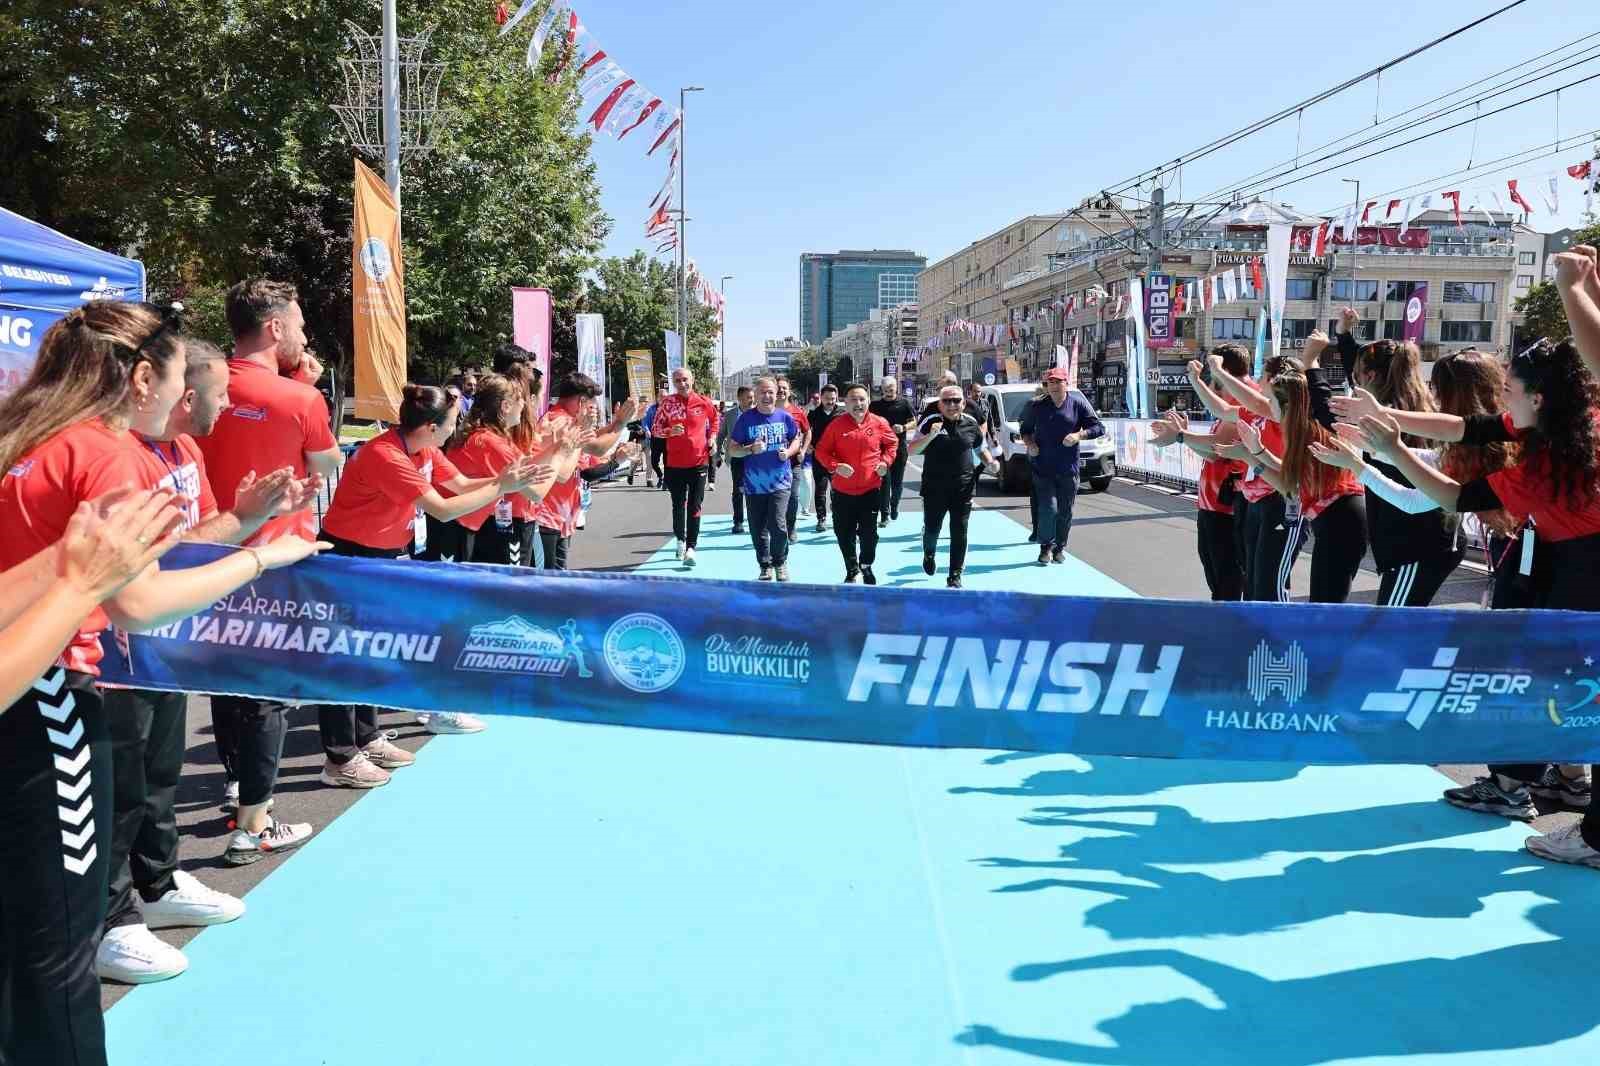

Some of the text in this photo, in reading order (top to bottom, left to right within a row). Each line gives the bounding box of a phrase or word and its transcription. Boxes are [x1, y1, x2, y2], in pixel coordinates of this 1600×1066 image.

[1217, 254, 1244, 264] TUANA
[1148, 371, 1159, 380] 30
[189, 615, 252, 646] YARI
[253, 622, 441, 663] MARATONU
[704, 633, 733, 653] Dr.
[734, 635, 810, 657] Memduh
[463, 652, 566, 673] MARATONU
[847, 632, 1184, 717] FINISH
[1447, 673, 1533, 695] SPOR
[1205, 709, 1340, 733] HALKBANK
